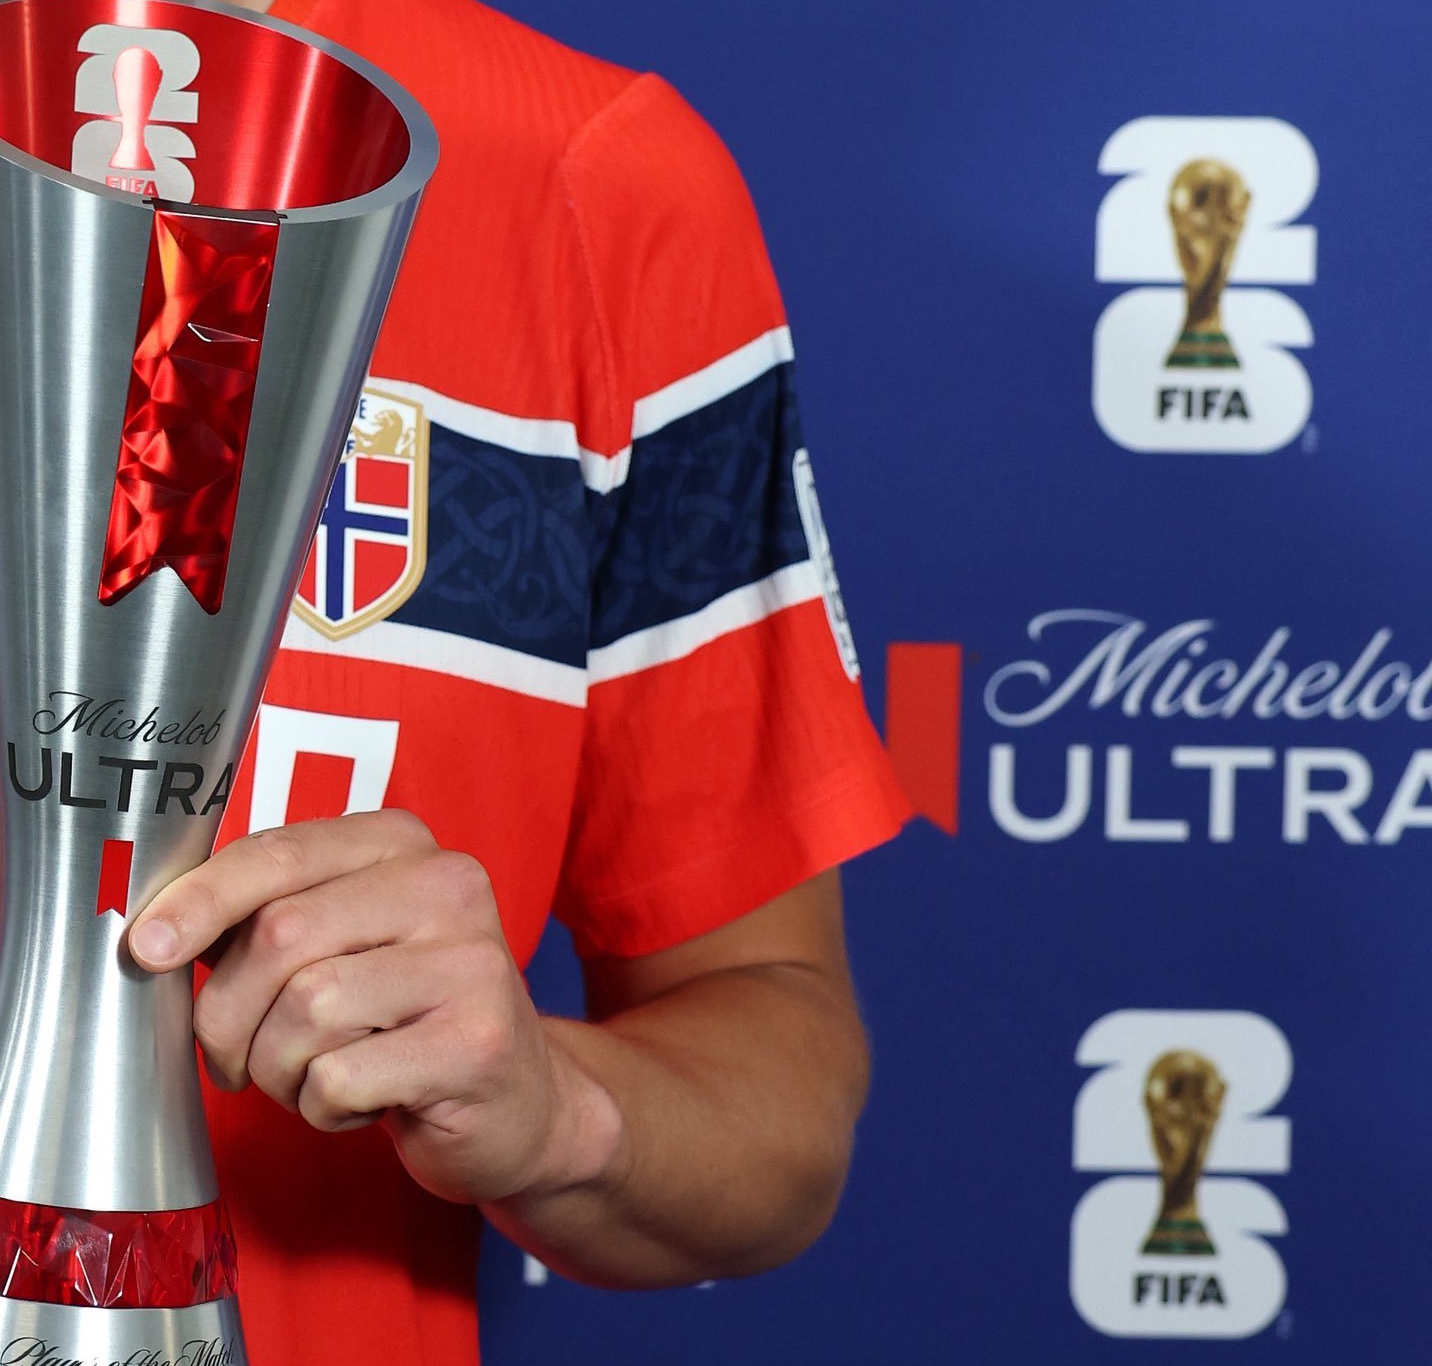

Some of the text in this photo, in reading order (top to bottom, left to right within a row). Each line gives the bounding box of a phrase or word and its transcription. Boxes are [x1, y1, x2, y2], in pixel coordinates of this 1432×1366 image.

[1156, 387, 1250, 421] FIFA
[32, 691, 226, 746] Michelob
[1133, 1273, 1226, 1306] FIFA
